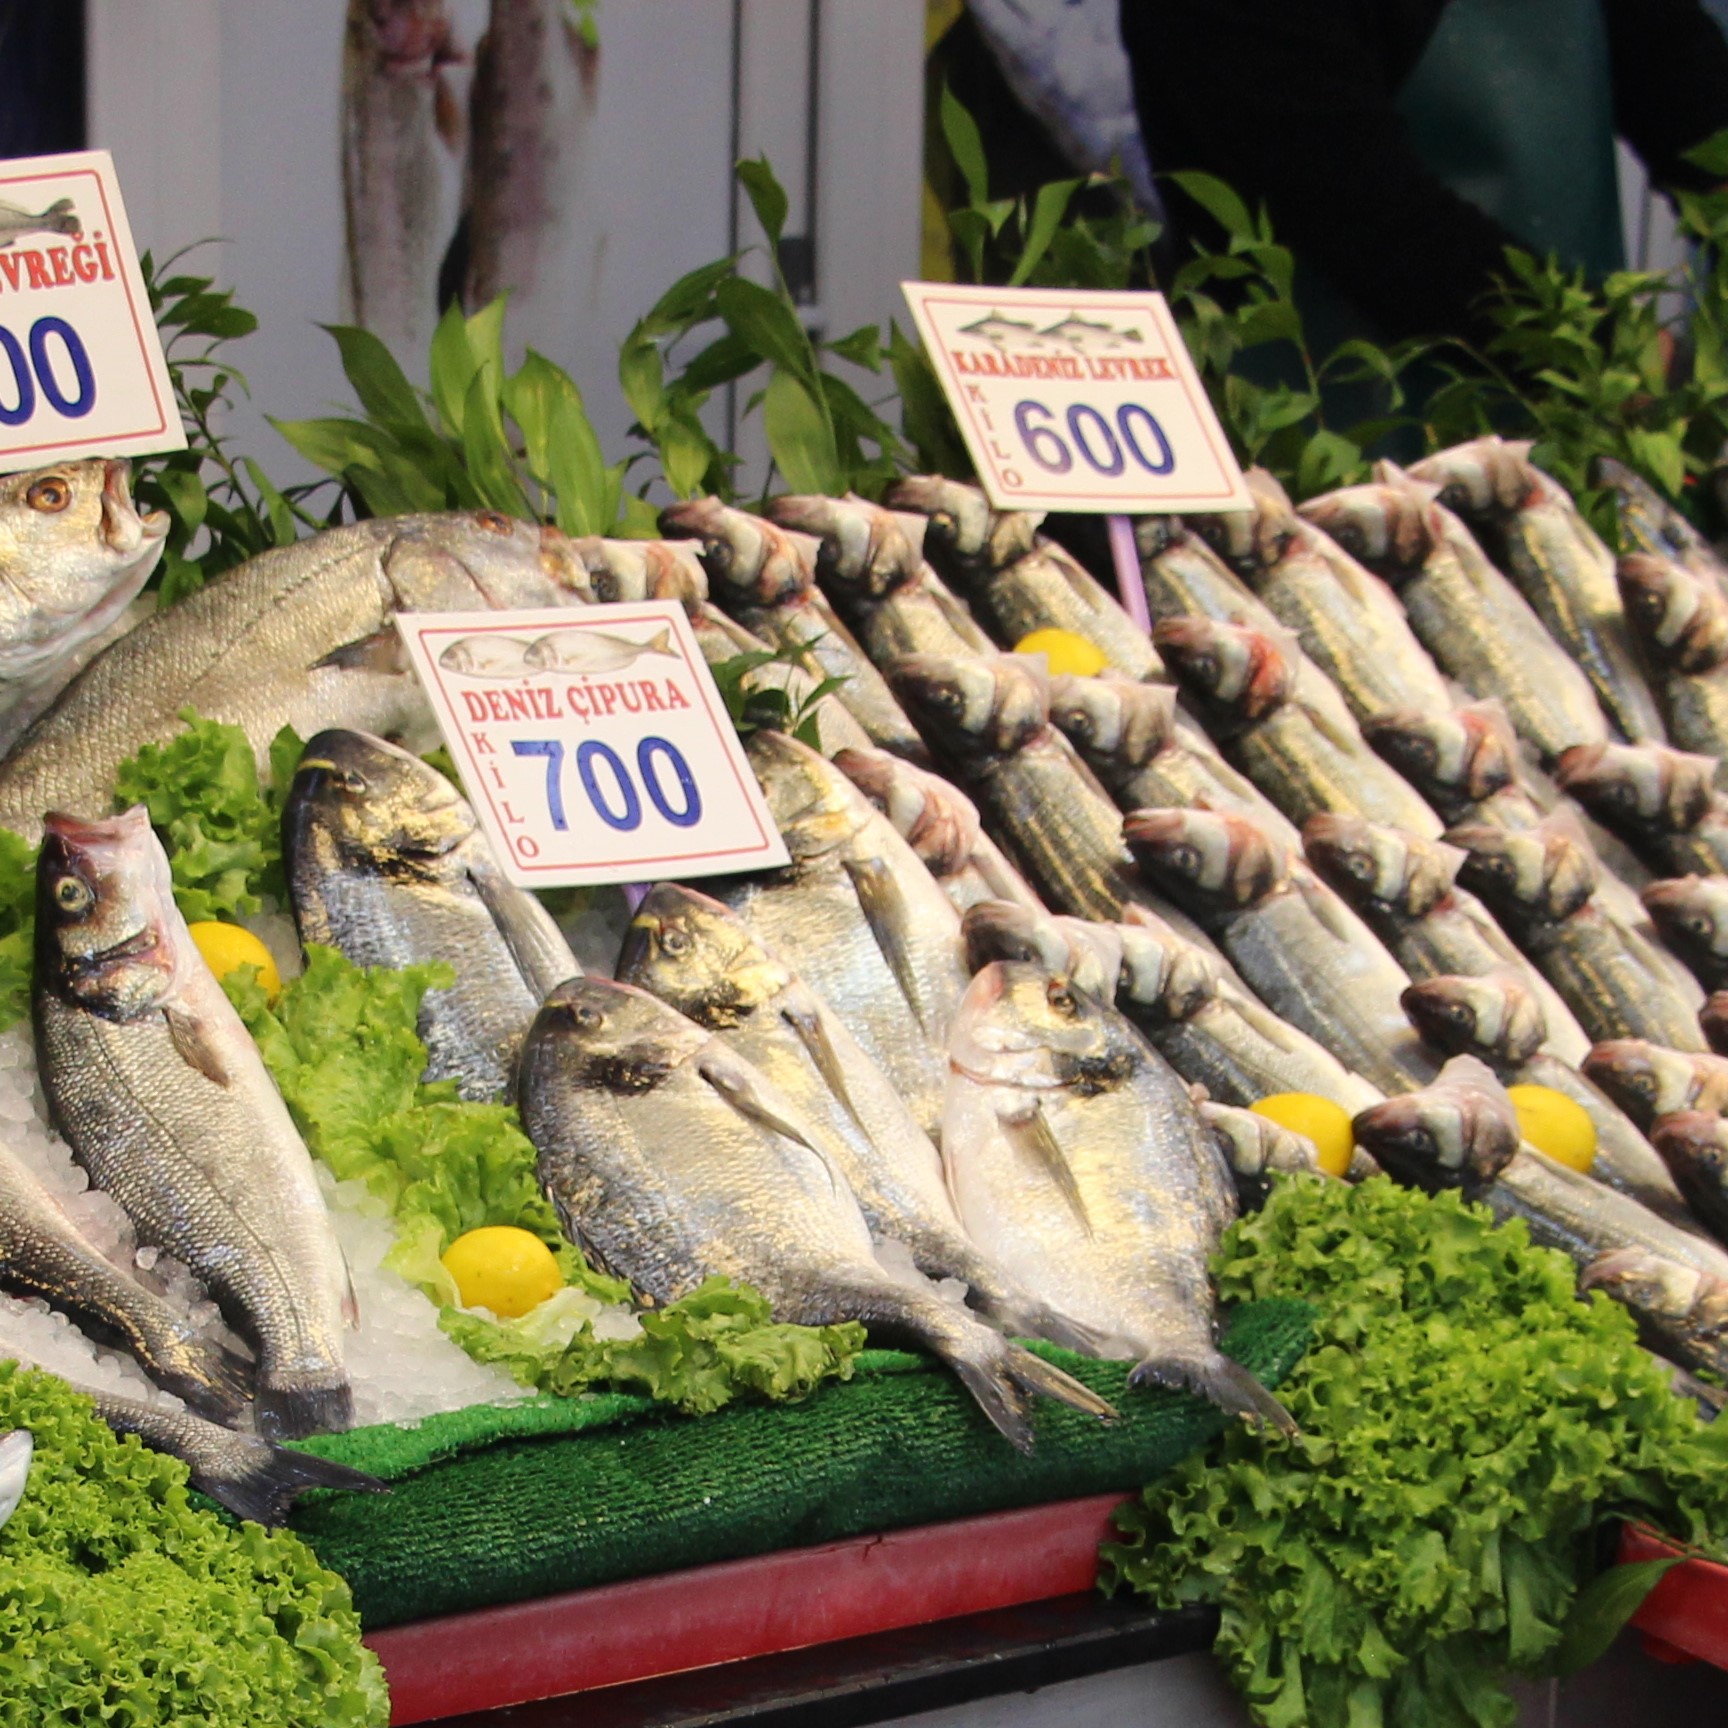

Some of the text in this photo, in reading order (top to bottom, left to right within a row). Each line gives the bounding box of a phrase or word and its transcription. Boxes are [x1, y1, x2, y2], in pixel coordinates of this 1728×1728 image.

[1087, 356, 1179, 381] LEVREK
[1014, 400, 1176, 477] 600
[461, 675, 691, 725] DENİZ ÇİPURA
[471, 731, 540, 858] KİLO
[510, 735, 703, 832] 700
